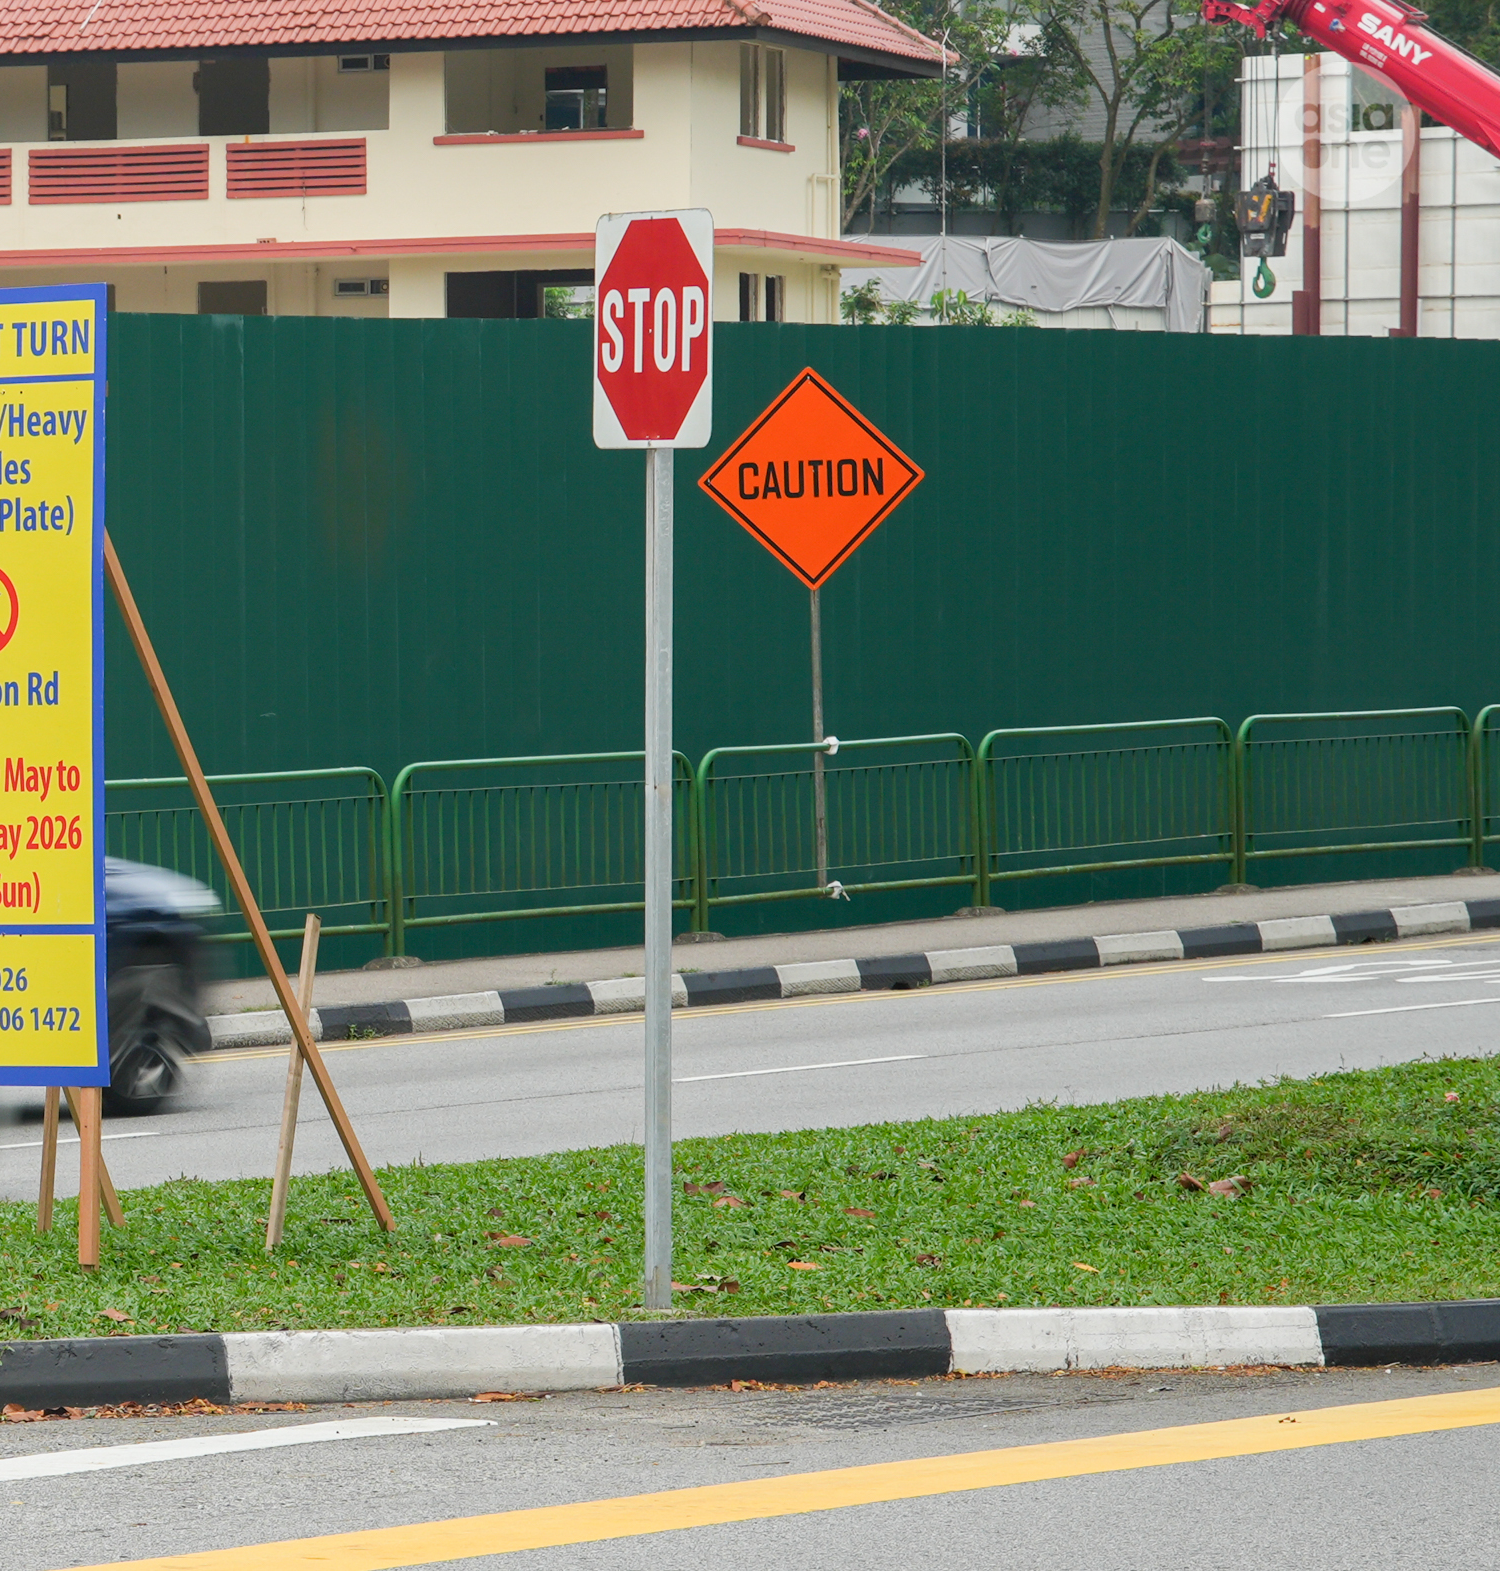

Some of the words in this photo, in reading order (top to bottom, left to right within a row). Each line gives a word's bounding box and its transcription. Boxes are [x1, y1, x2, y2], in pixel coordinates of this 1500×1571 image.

[1357, 12, 1433, 66] SANY
[13, 318, 90, 357] TURN
[601, 285, 705, 374] STOP
[738, 457, 885, 500] CAUTION
[27, 670, 59, 706] Rd
[4, 757, 53, 802] May
[56, 759, 81, 792] to
[25, 814, 83, 850] 2026
[30, 1006, 81, 1031] 1472
